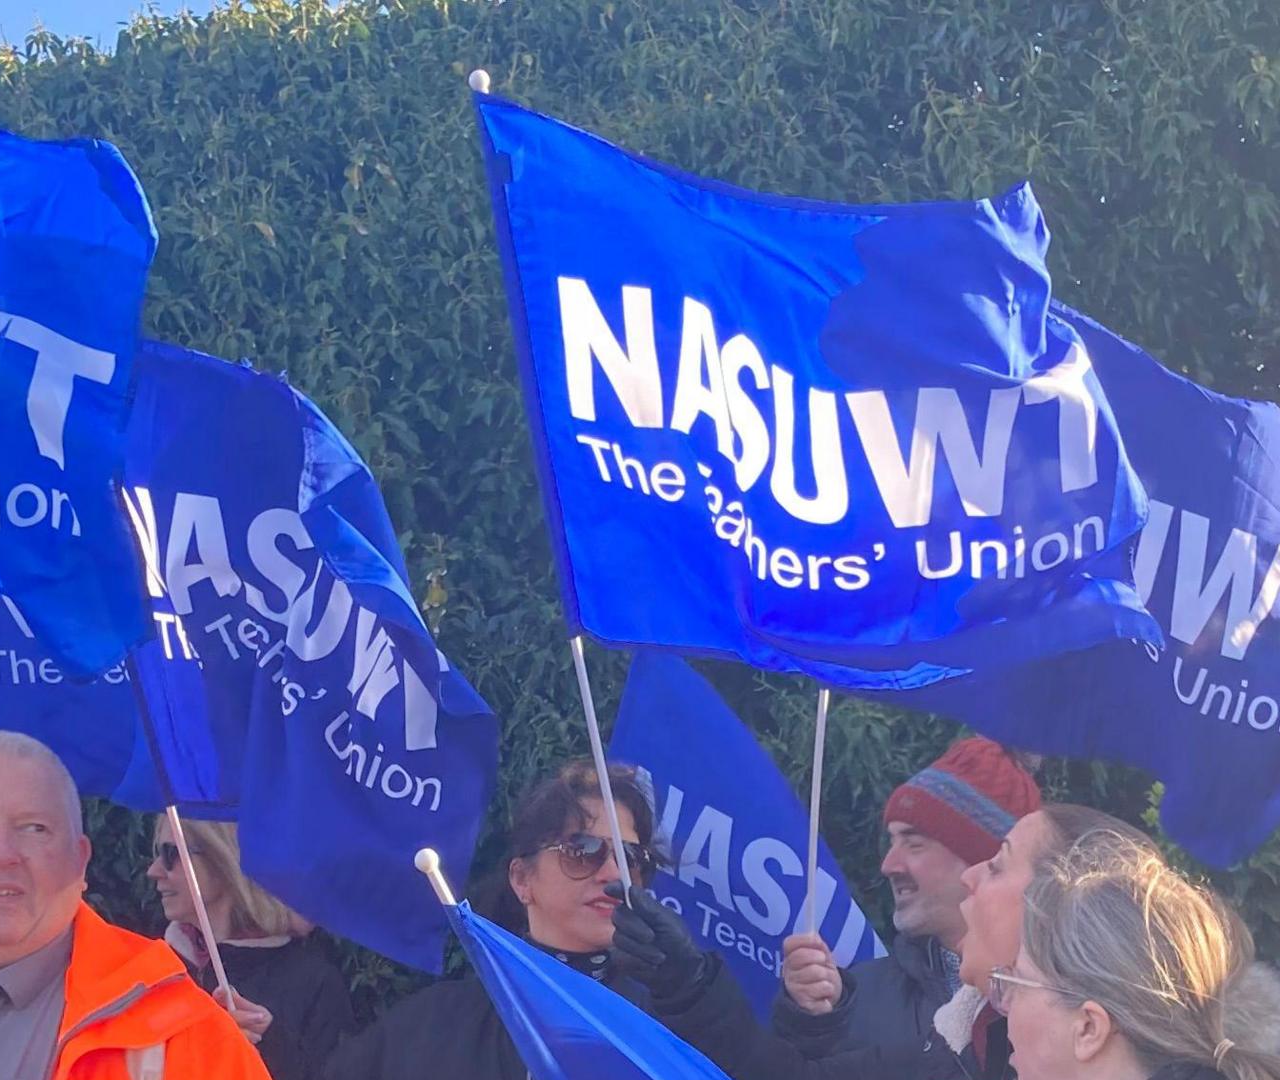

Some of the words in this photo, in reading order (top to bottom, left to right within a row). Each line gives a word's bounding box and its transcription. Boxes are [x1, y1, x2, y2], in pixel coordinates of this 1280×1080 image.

[557, 276, 1099, 529] NASUWT
[577, 434, 687, 502] The
[915, 515, 1105, 581] Union
